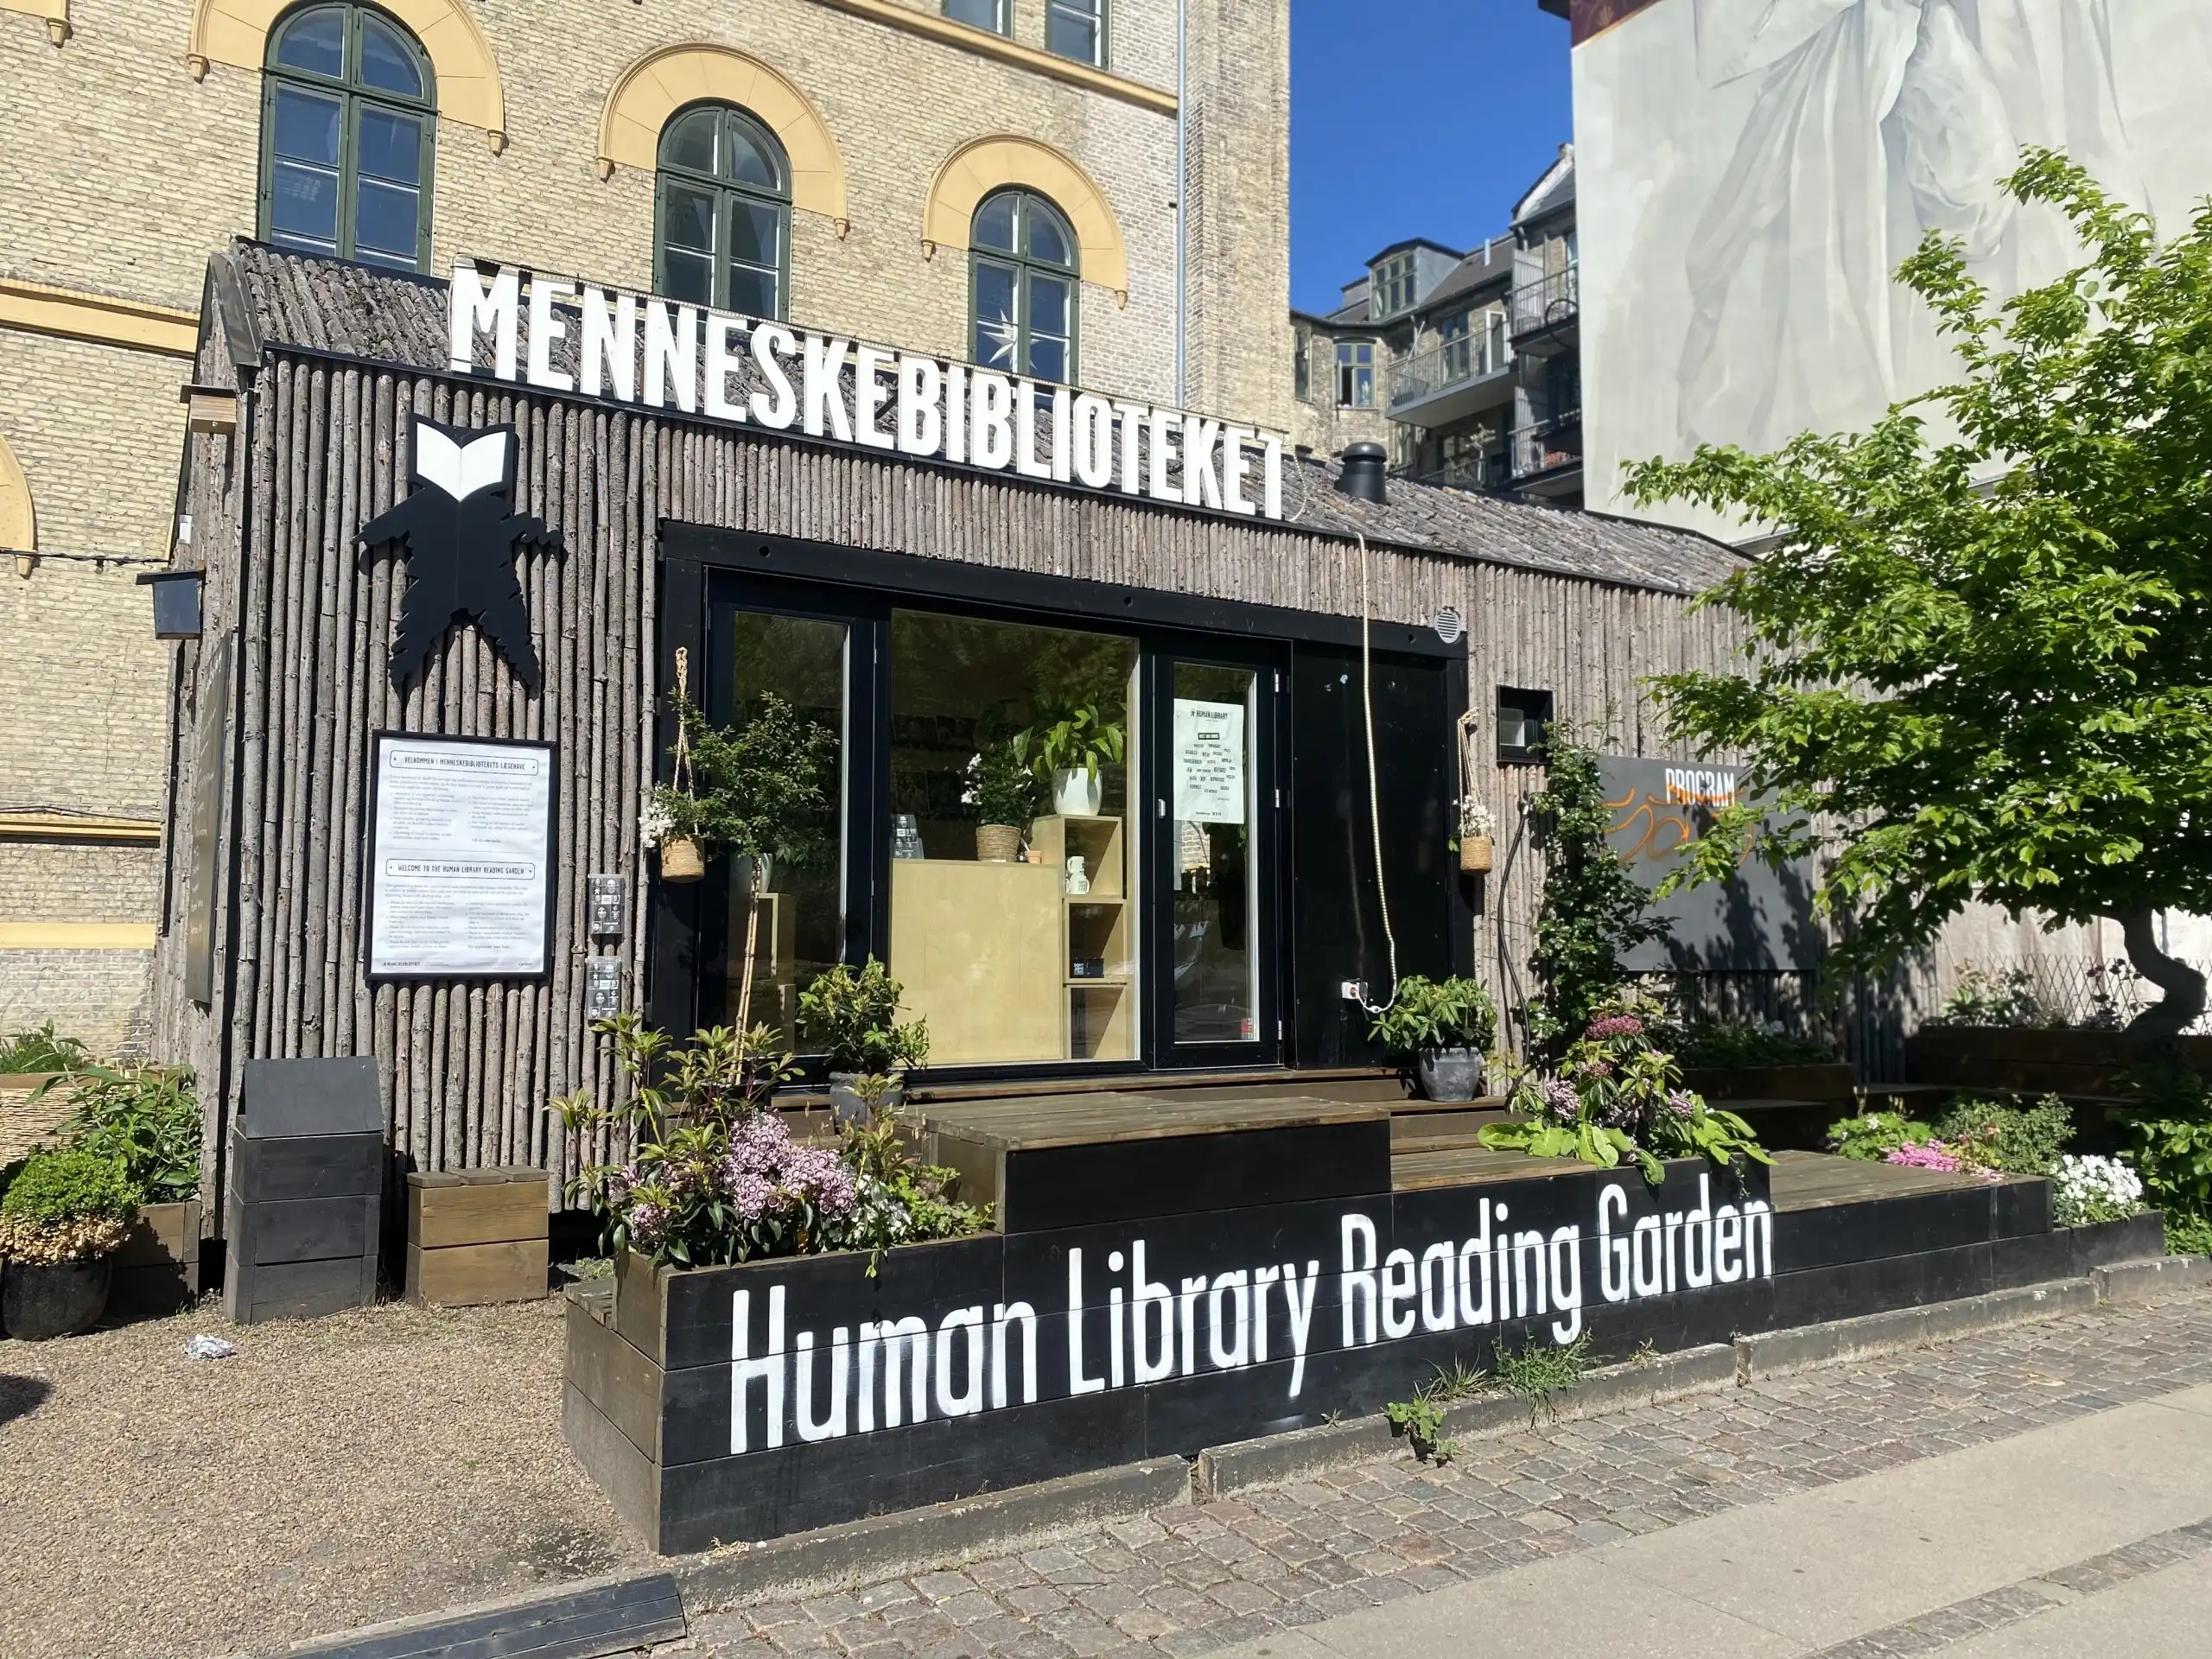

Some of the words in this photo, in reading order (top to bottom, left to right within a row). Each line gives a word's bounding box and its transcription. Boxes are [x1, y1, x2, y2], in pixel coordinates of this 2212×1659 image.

[449, 259, 1283, 521] MENNESKEBIBLIOTEKET
[1196, 710, 1211, 719] HUMAN
[1211, 711, 1228, 720] LIBRARY
[404, 756, 435, 765] VELKOMMEN
[440, 758, 499, 769] MENNESKEBIBLIOTEKETS
[1665, 767, 1735, 807] PROGRAM
[729, 1283, 1039, 1455] Human
[1068, 1239, 1319, 1399] Library
[1340, 1198, 1581, 1344] Reading
[1599, 1172, 1774, 1300] Garden
